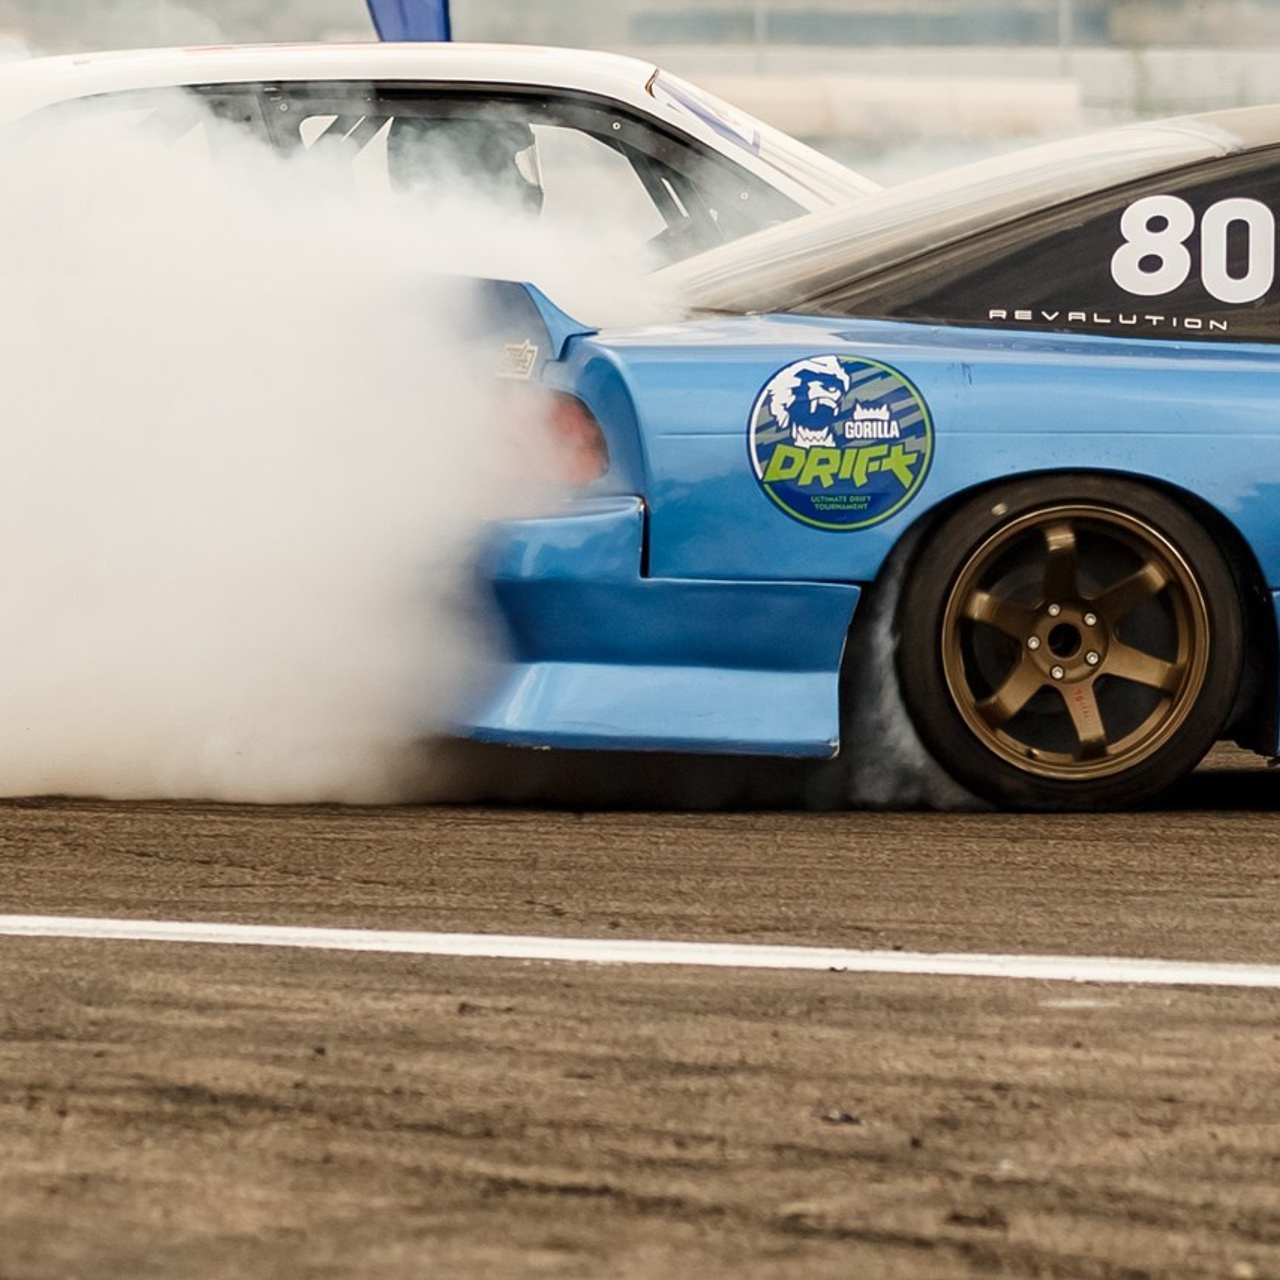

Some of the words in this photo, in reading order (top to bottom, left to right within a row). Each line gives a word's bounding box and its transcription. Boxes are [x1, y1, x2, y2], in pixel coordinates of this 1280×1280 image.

[1111, 195, 1275, 304] 80
[988, 309, 1228, 331] REVALUTION
[844, 420, 899, 439] GORILLA
[763, 443, 918, 489] DRIFT
